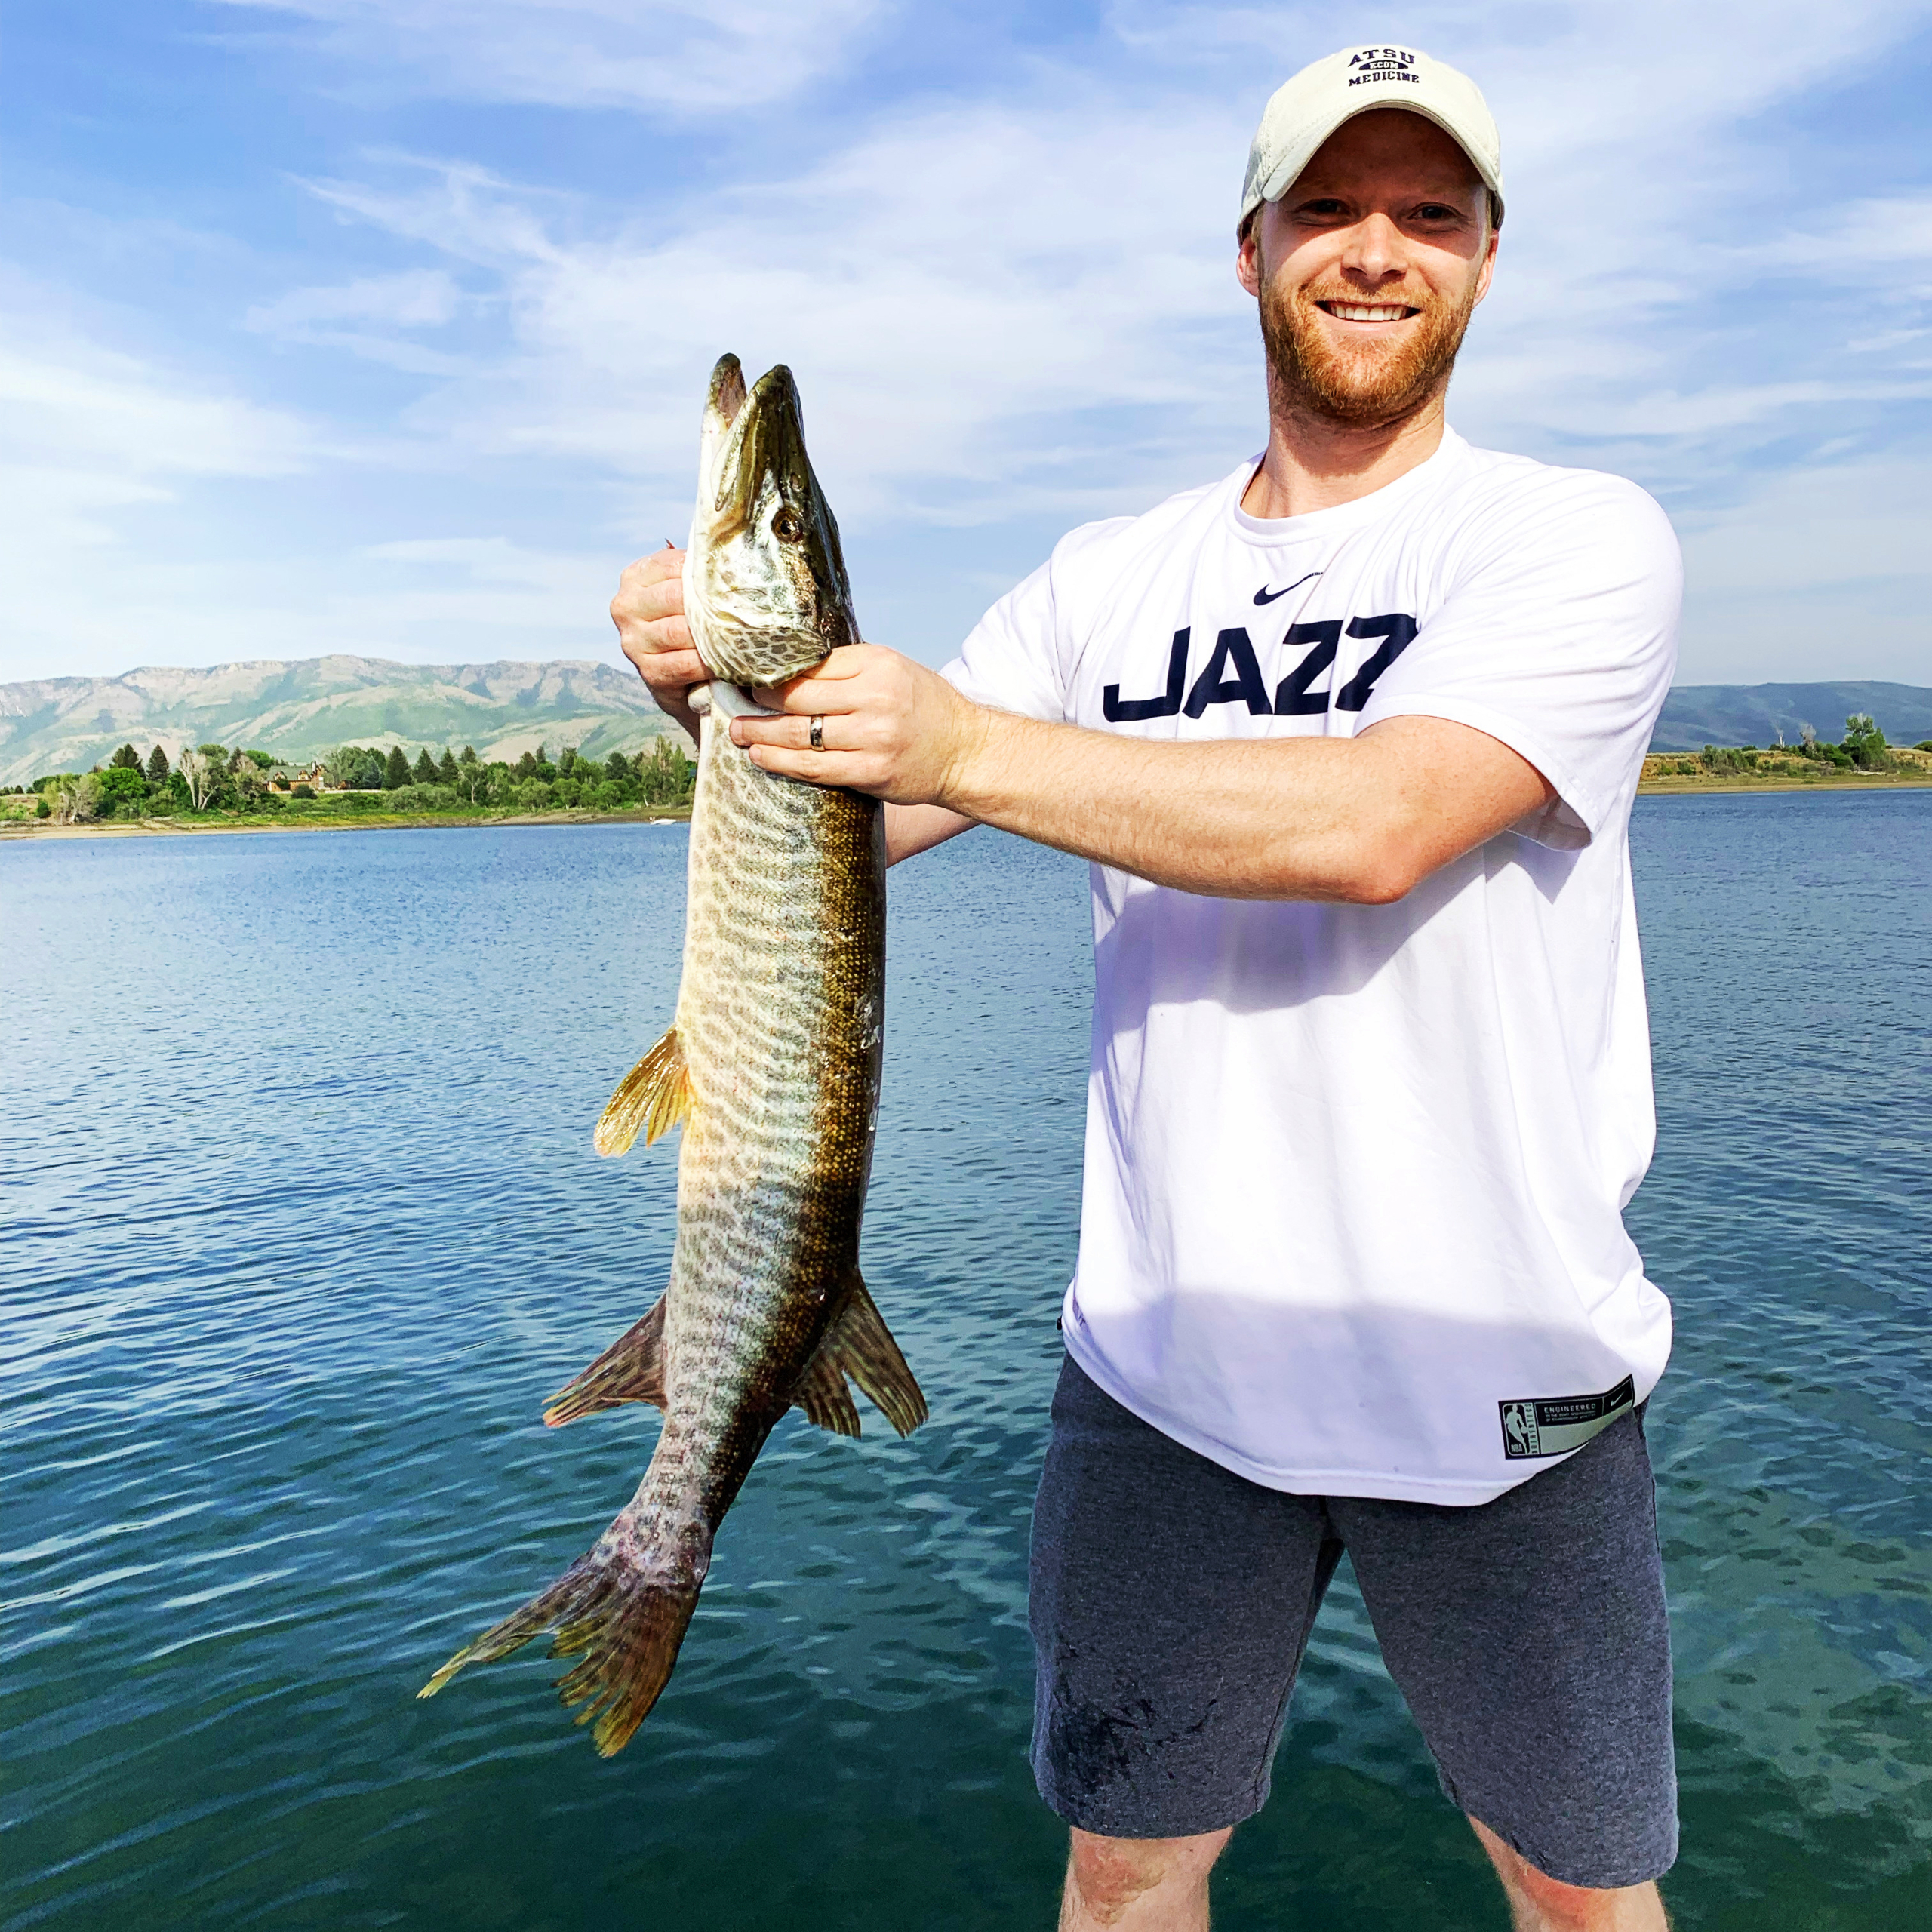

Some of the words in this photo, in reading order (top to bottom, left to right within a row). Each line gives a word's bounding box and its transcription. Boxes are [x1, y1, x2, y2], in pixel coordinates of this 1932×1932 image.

[1348, 49, 1415, 67] ATSU
[1349, 71, 1420, 87] MEDICINE
[1103, 613, 1419, 722] JAZZ
[1543, 1403, 1596, 1414] ENGINEERED
